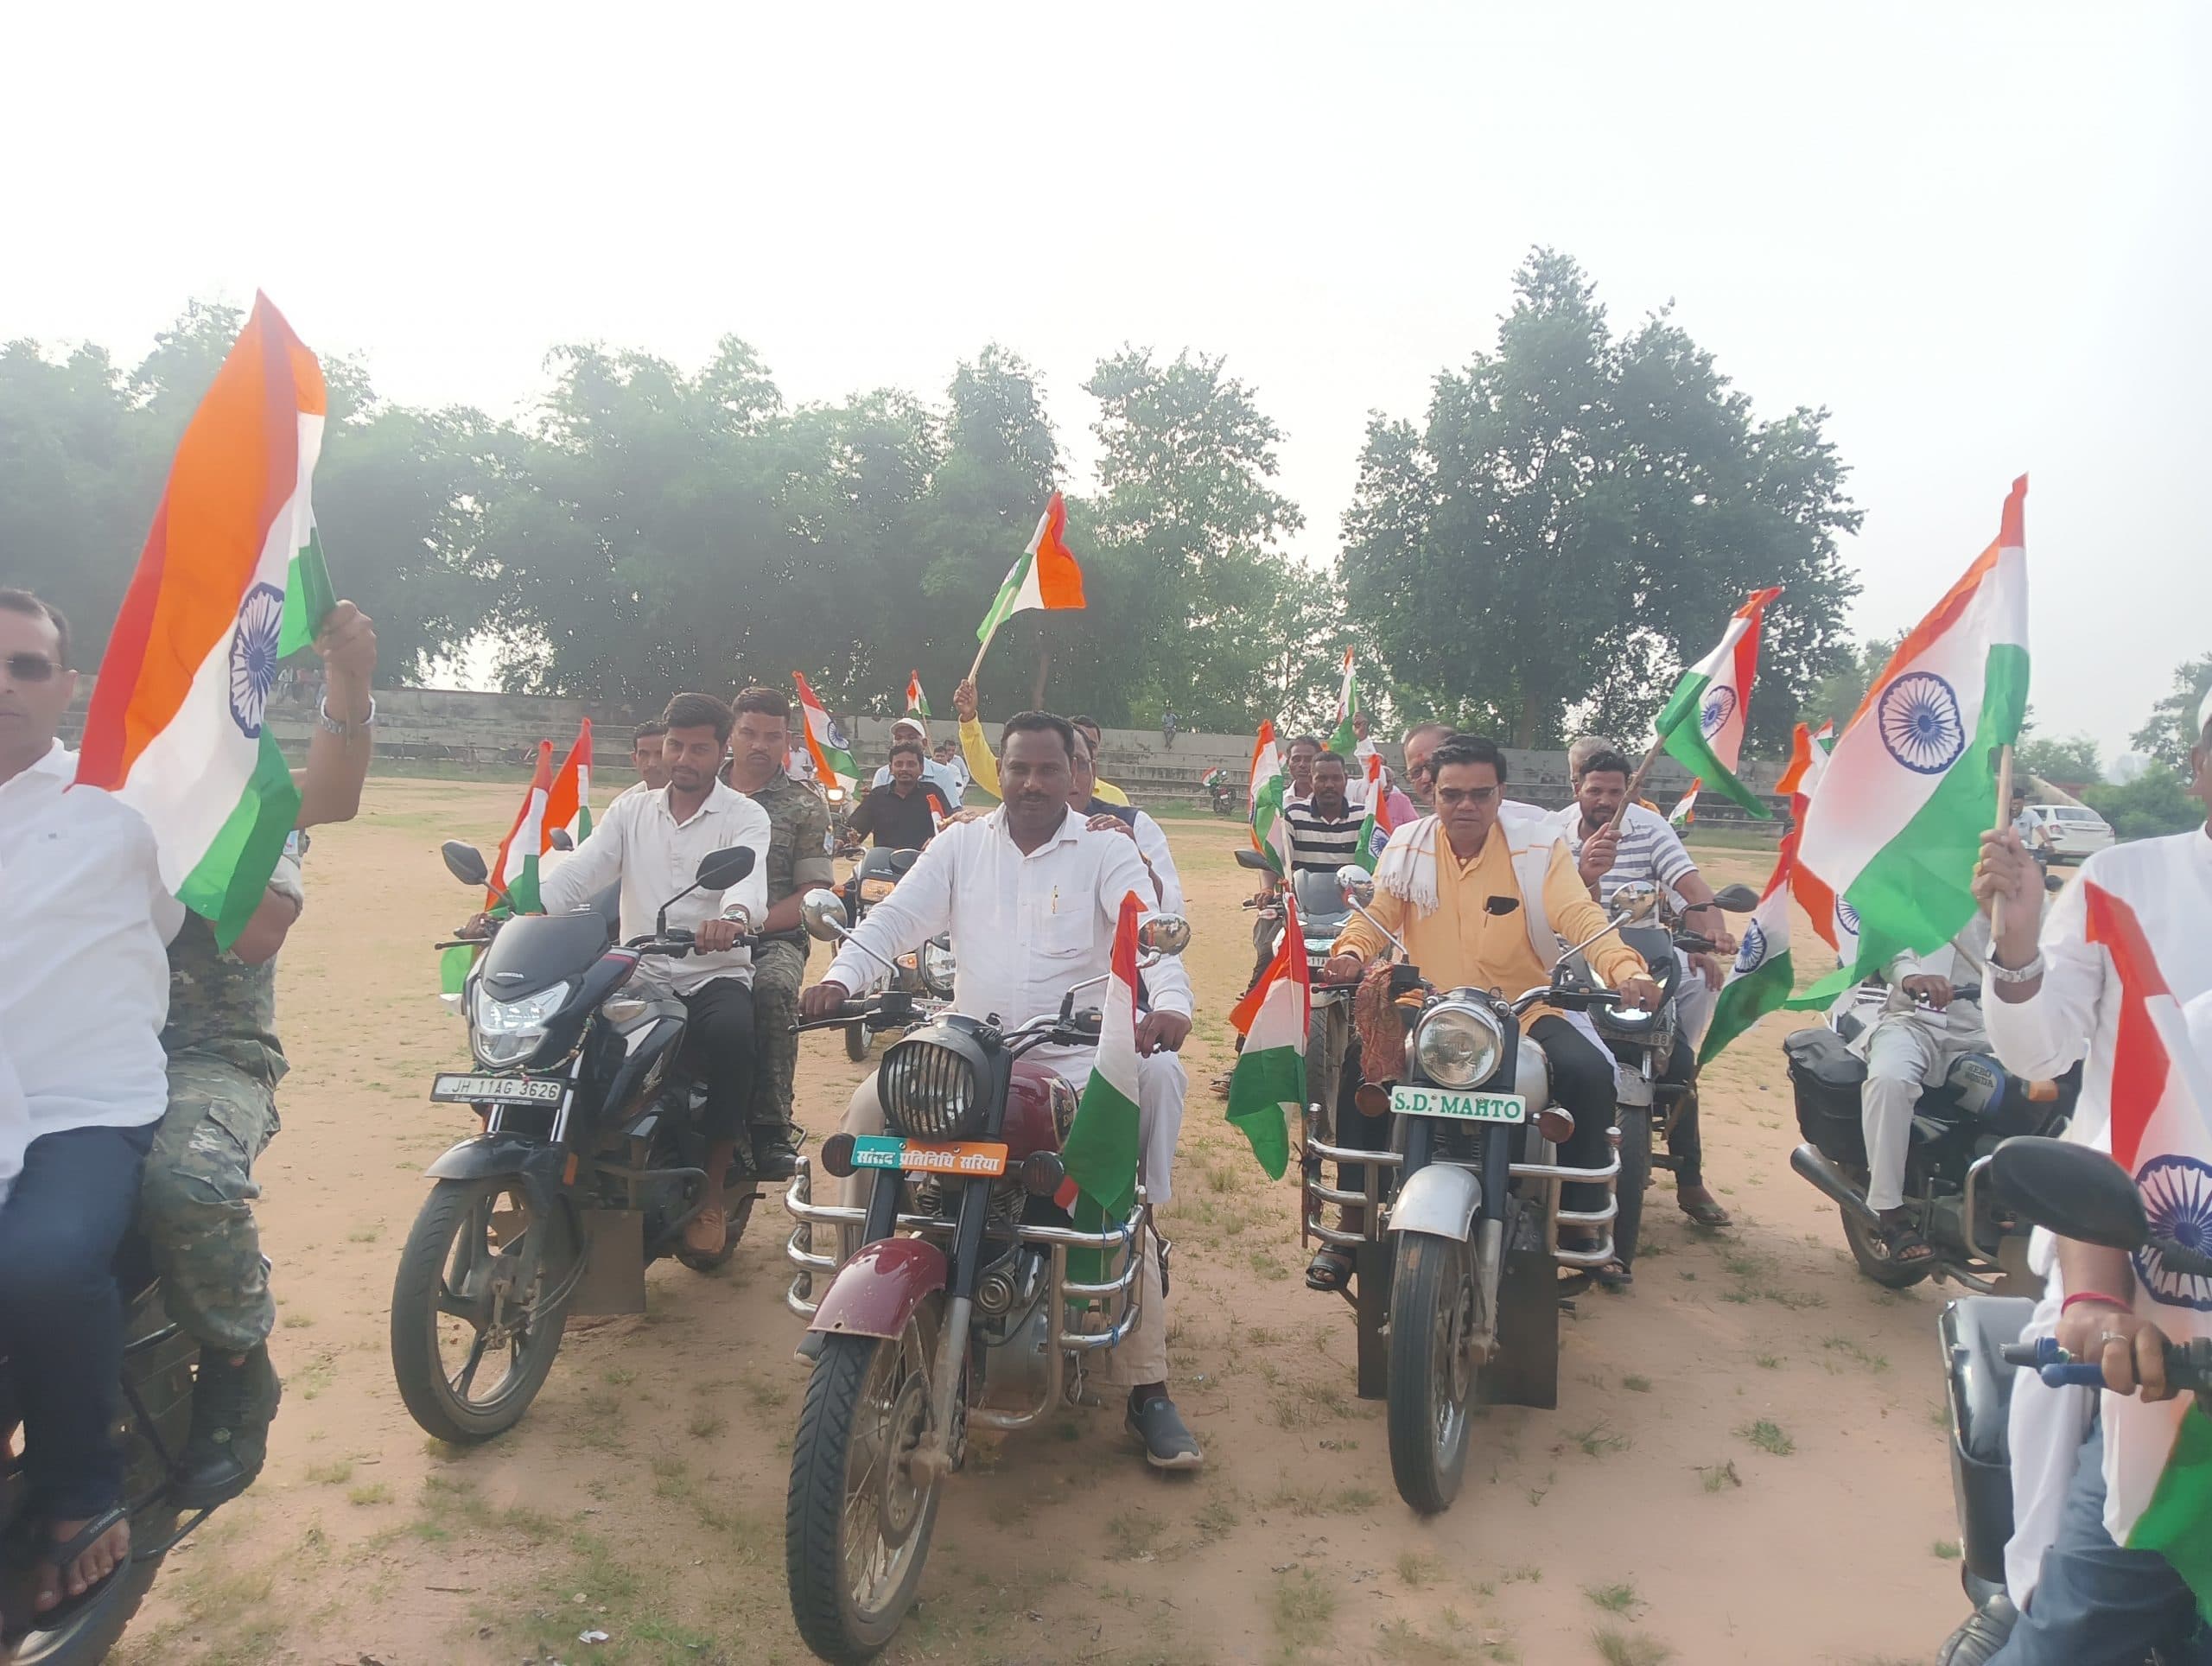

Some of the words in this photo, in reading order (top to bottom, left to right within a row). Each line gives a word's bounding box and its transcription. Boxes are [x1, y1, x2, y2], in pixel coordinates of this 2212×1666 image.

[452, 1080, 471, 1094] JH
[479, 1079, 512, 1095] 11AG
[519, 1082, 559, 1099] 3626
[1395, 1092, 1433, 1112] S.D.
[1440, 1095, 1521, 1118] MAHTO
[857, 1148, 896, 1165] सांसद
[899, 1149, 956, 1167] प्रतिनिधि
[959, 1154, 1001, 1171] सरिया
